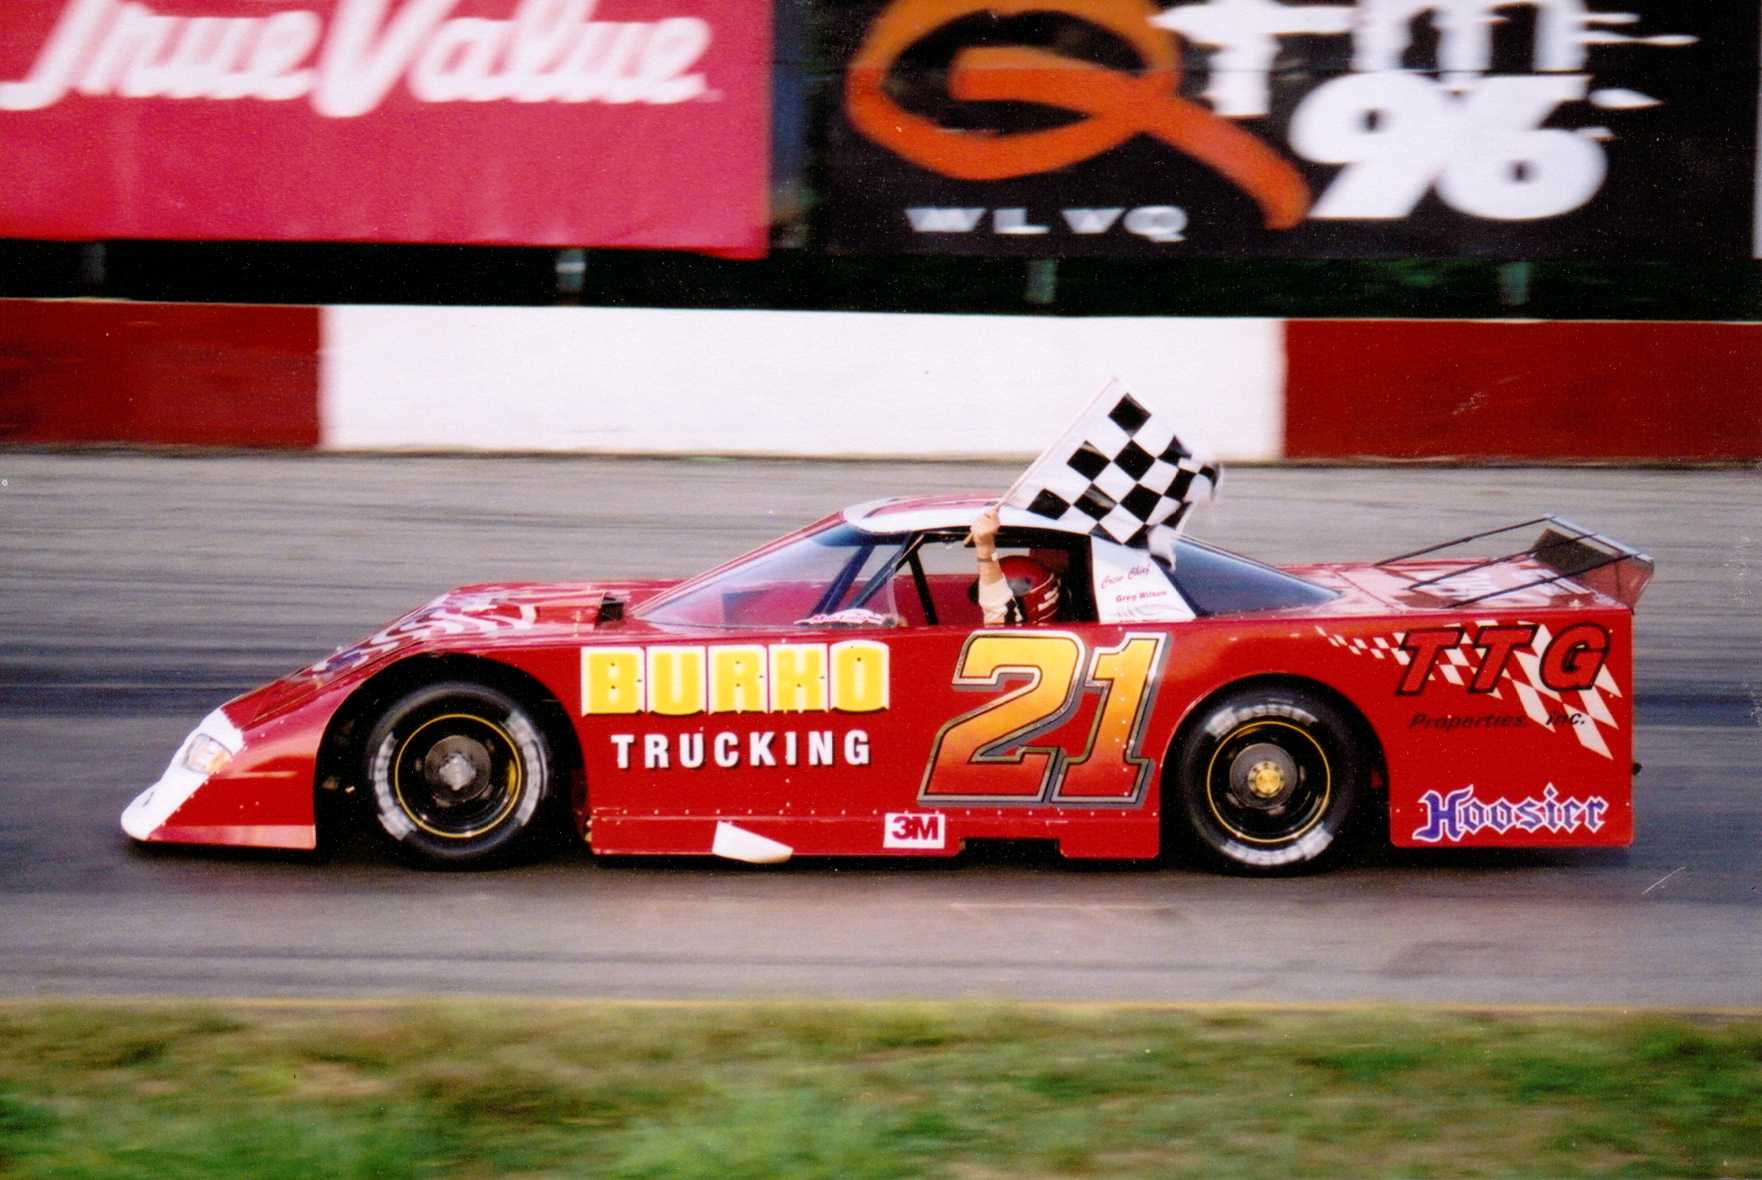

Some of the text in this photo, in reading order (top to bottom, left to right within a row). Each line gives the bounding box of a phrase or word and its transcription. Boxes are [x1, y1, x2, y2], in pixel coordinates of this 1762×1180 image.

[310, 0, 711, 118] Value
[1288, 72, 1608, 219] 96
[580, 640, 890, 717] BURKO
[1395, 623, 1611, 696] TTG
[610, 729, 870, 768] TRUCKING
[917, 629, 1171, 807] 21
[891, 816, 939, 841] 3M
[1412, 782, 1610, 842] Hoosier
